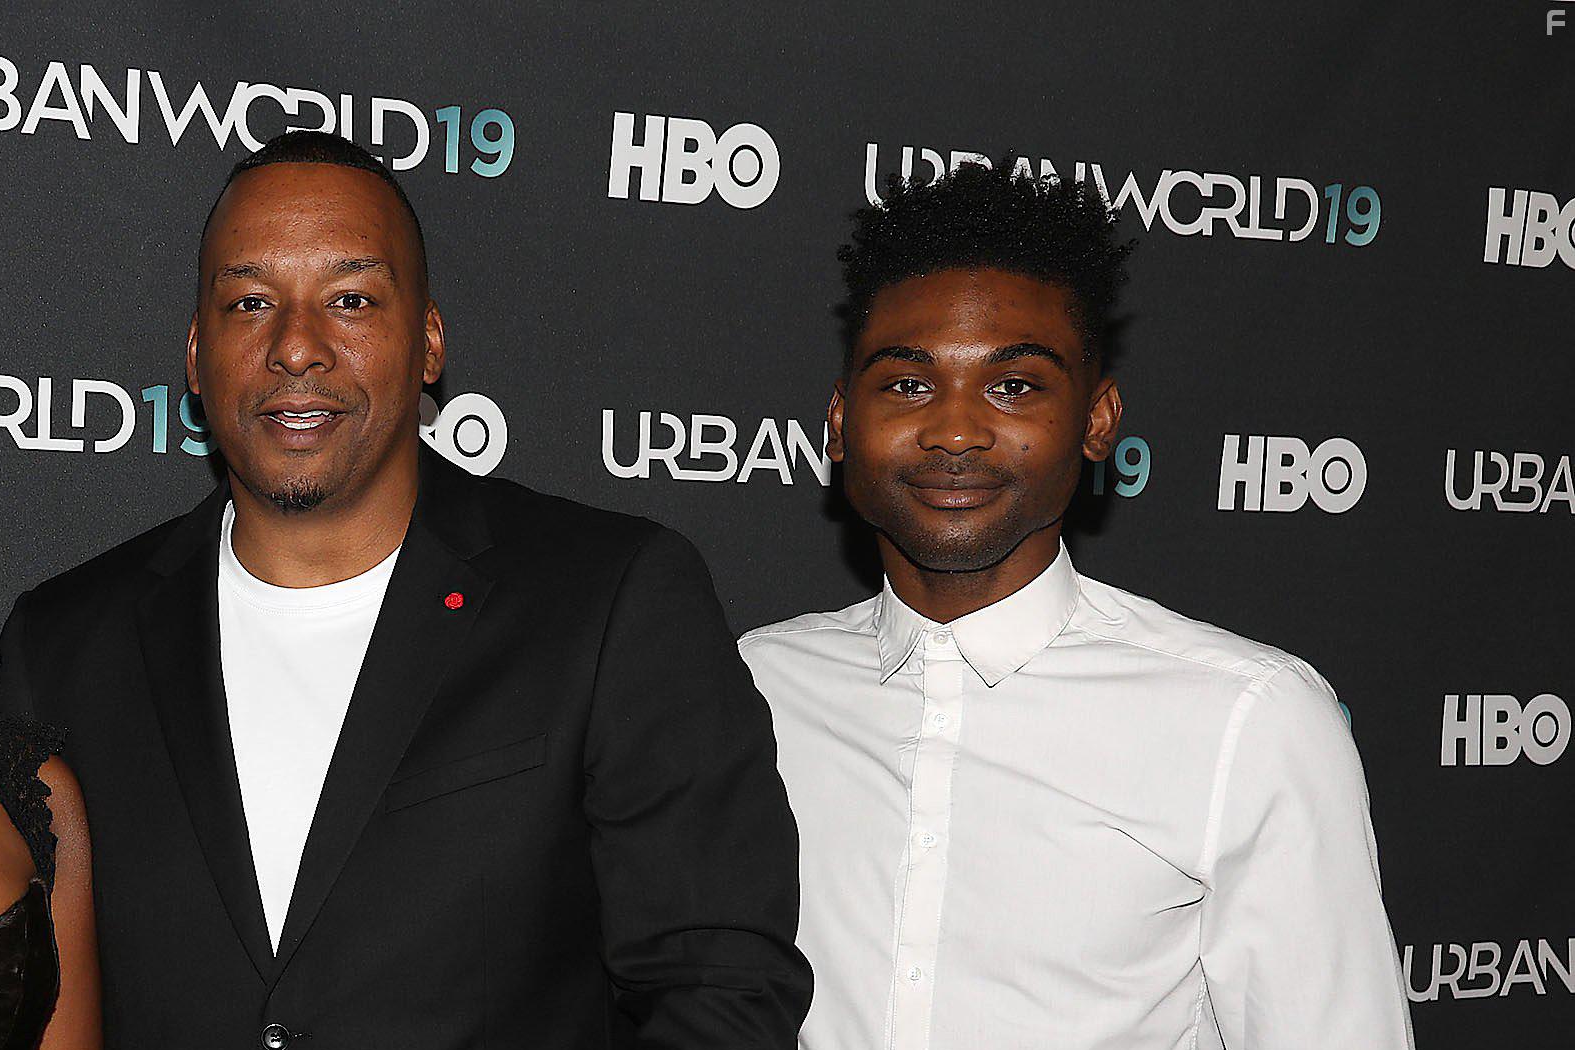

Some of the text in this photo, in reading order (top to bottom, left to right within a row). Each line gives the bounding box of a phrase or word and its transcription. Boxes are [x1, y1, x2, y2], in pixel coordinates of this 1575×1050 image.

[608, 112, 781, 209] HBO
[1218, 434, 1367, 514] HBO
[1440, 693, 1571, 767] HBO
